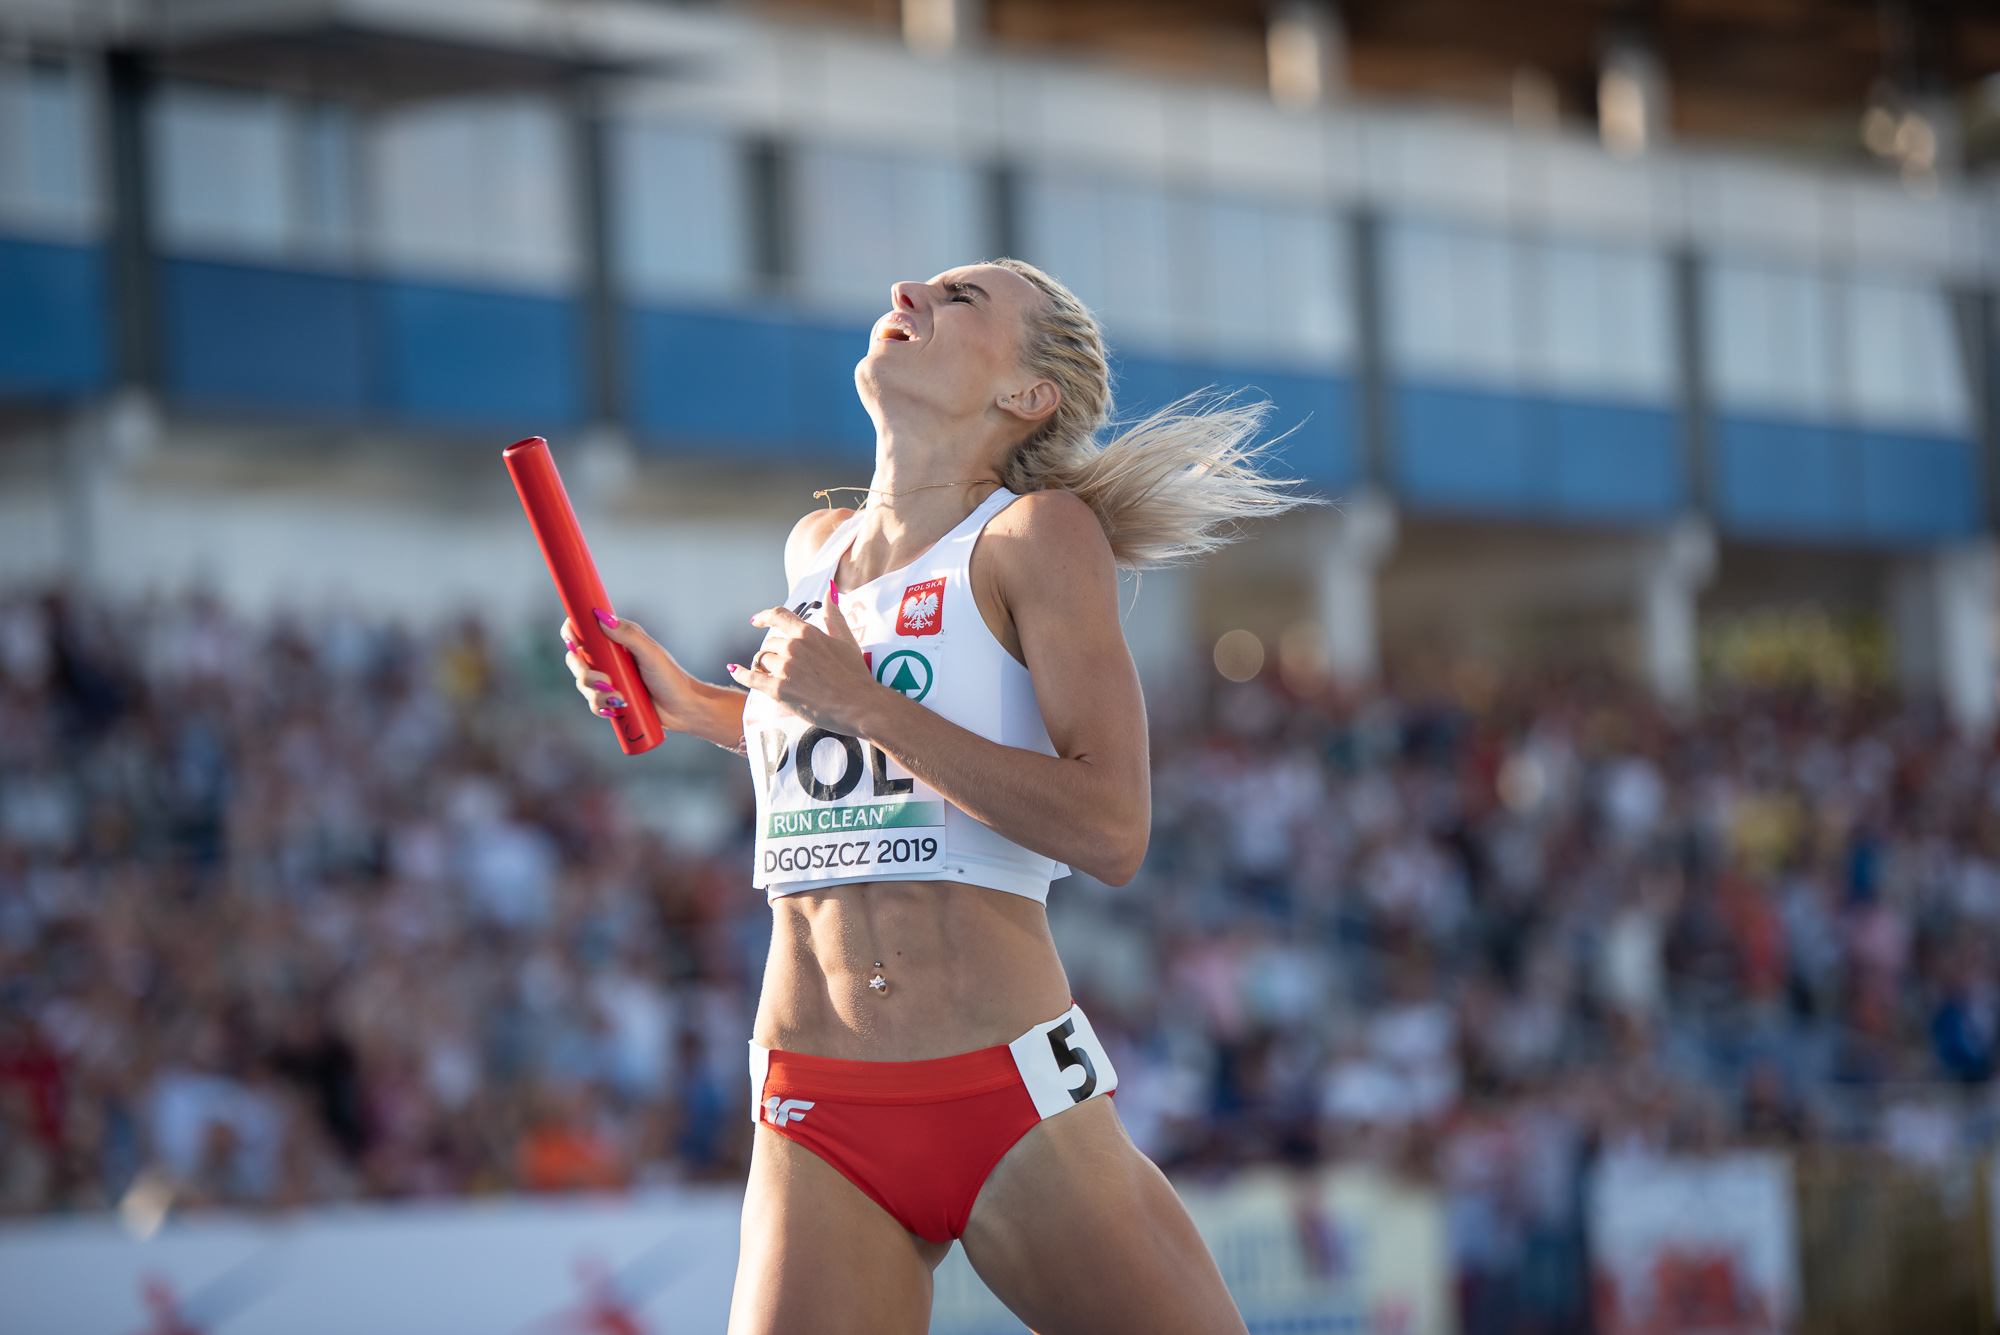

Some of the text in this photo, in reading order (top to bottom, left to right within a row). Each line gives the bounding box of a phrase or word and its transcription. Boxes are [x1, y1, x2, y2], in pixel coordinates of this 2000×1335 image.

[908, 580, 943, 593] POLSKA
[760, 725, 914, 802] POL
[774, 813, 812, 834] RUN
[877, 838, 938, 864] 2019
[1046, 1017, 1098, 1104] 5
